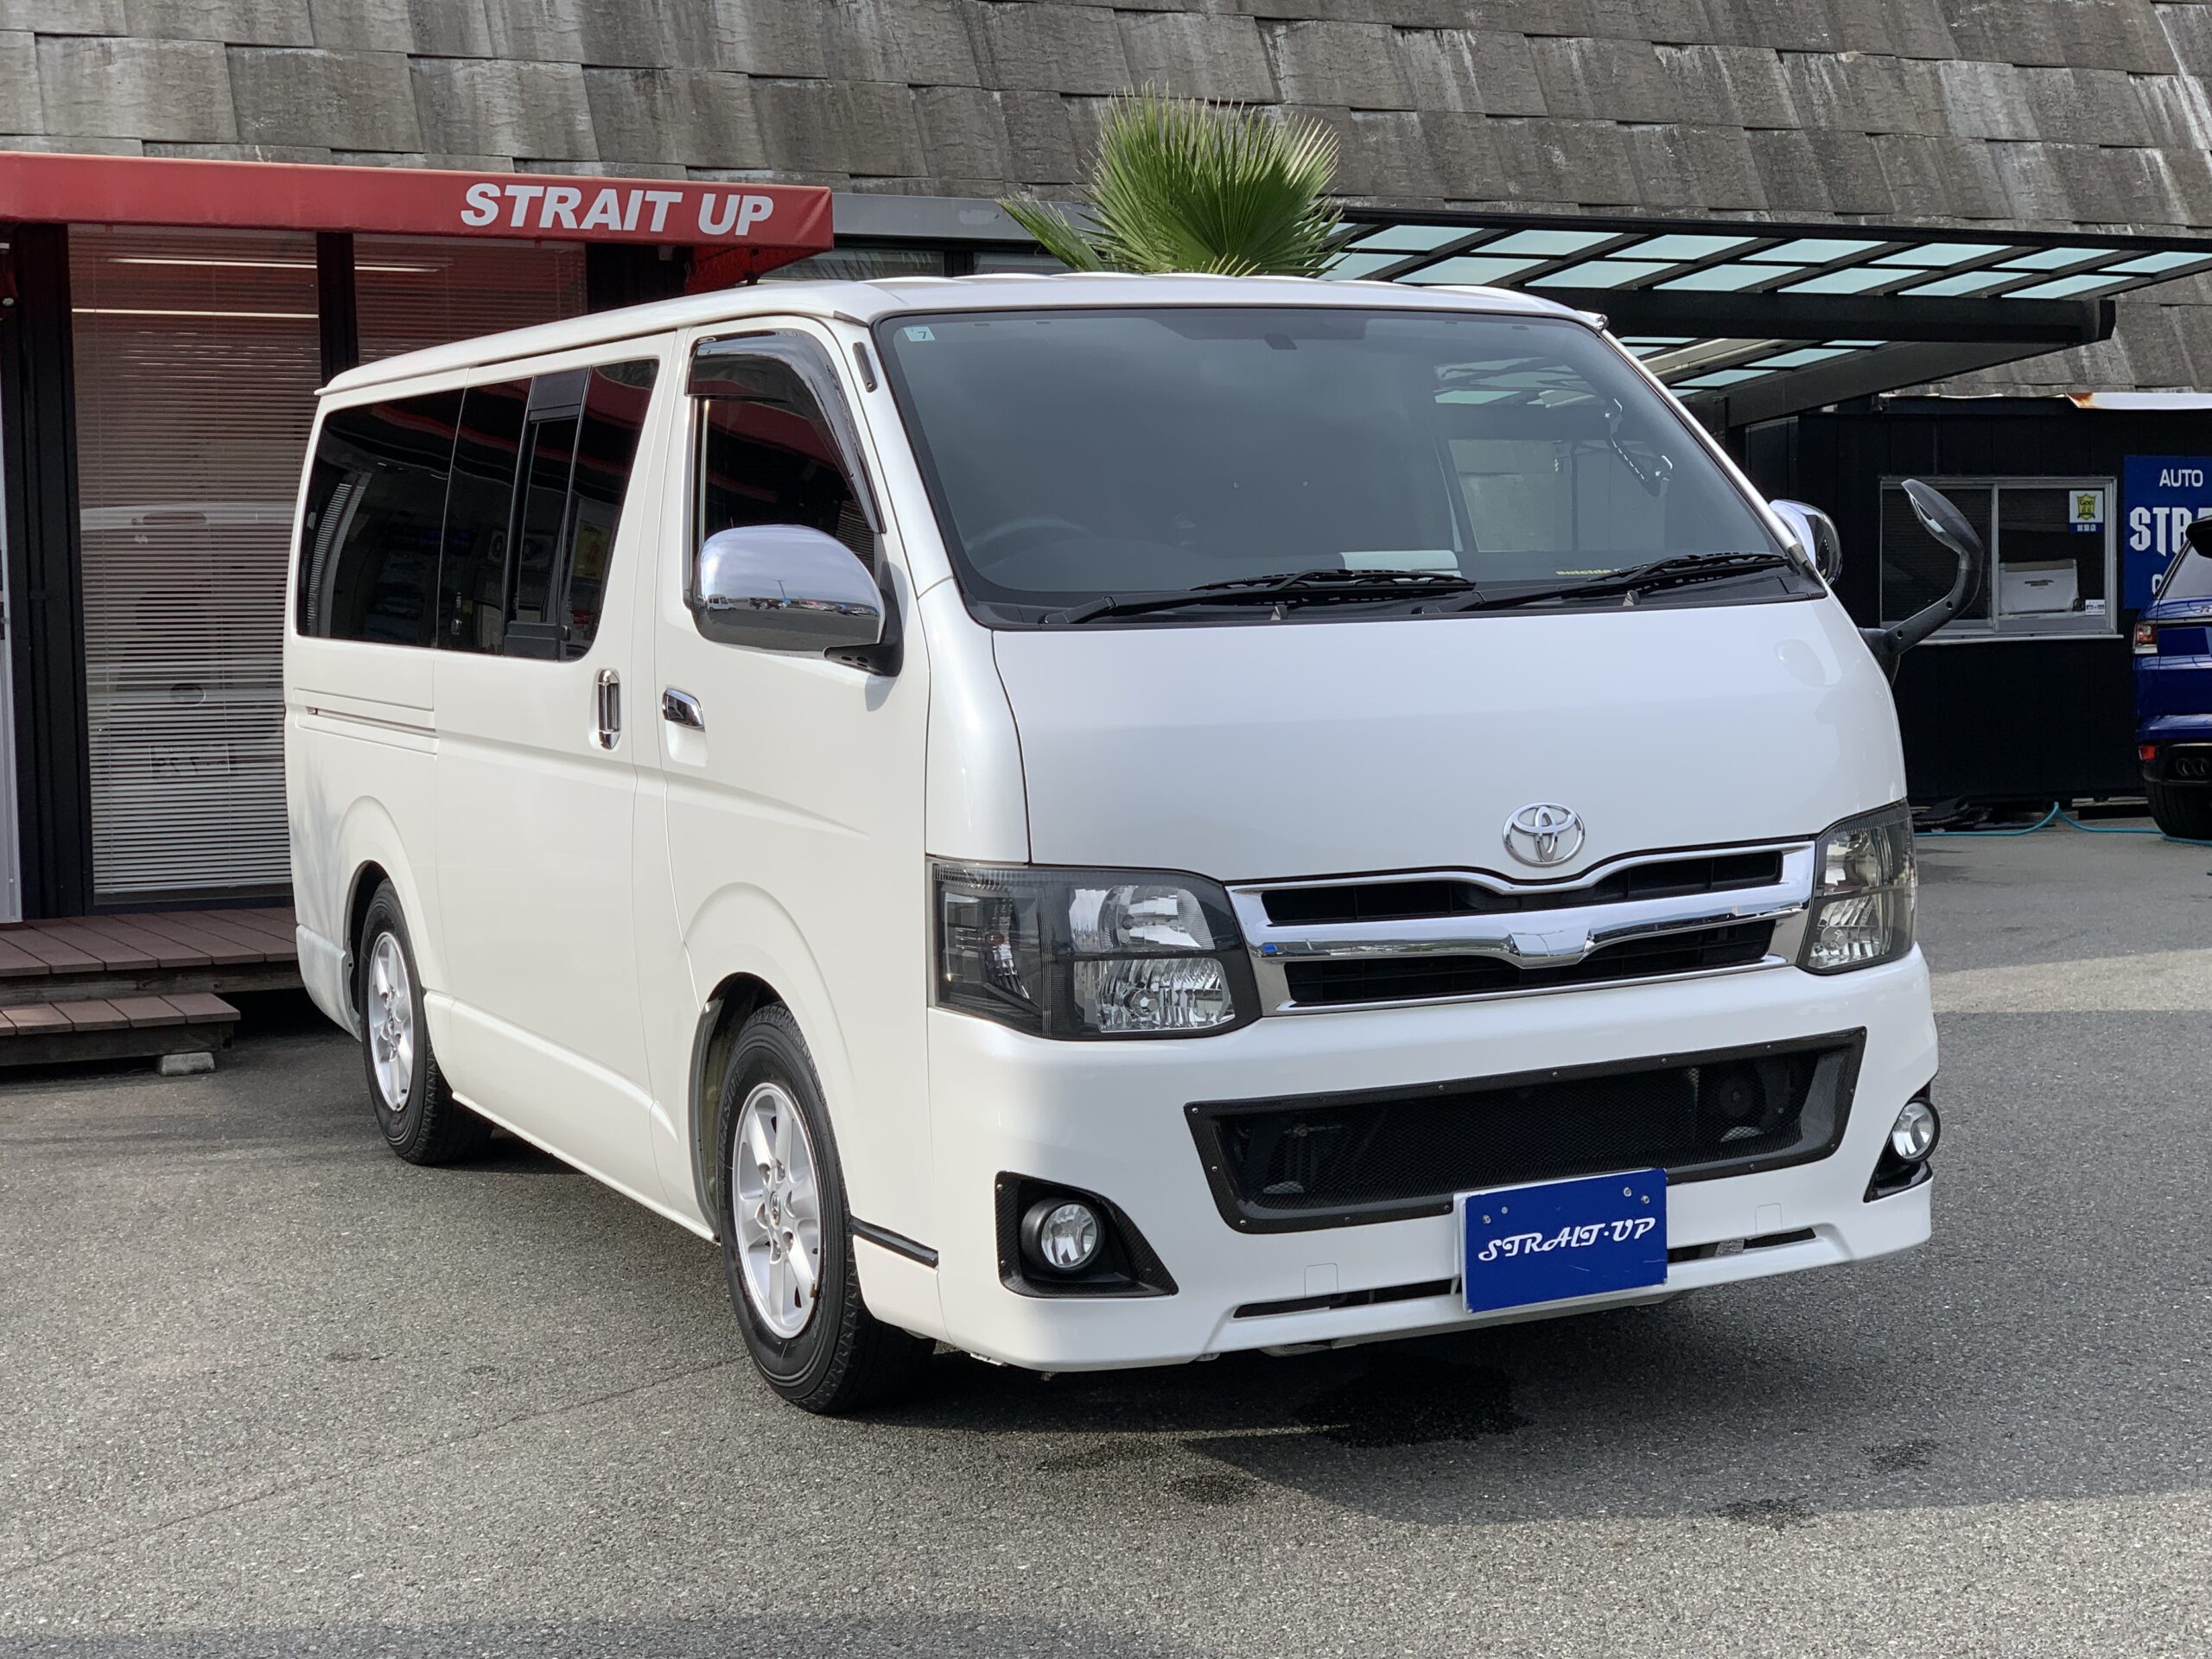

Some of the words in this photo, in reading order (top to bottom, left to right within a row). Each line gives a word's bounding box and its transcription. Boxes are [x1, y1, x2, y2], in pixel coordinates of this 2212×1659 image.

[461, 183, 683, 232] STRAIT
[698, 193, 773, 236] UP
[2159, 469, 2203, 487] AUTO
[2130, 506, 2212, 556] STR
